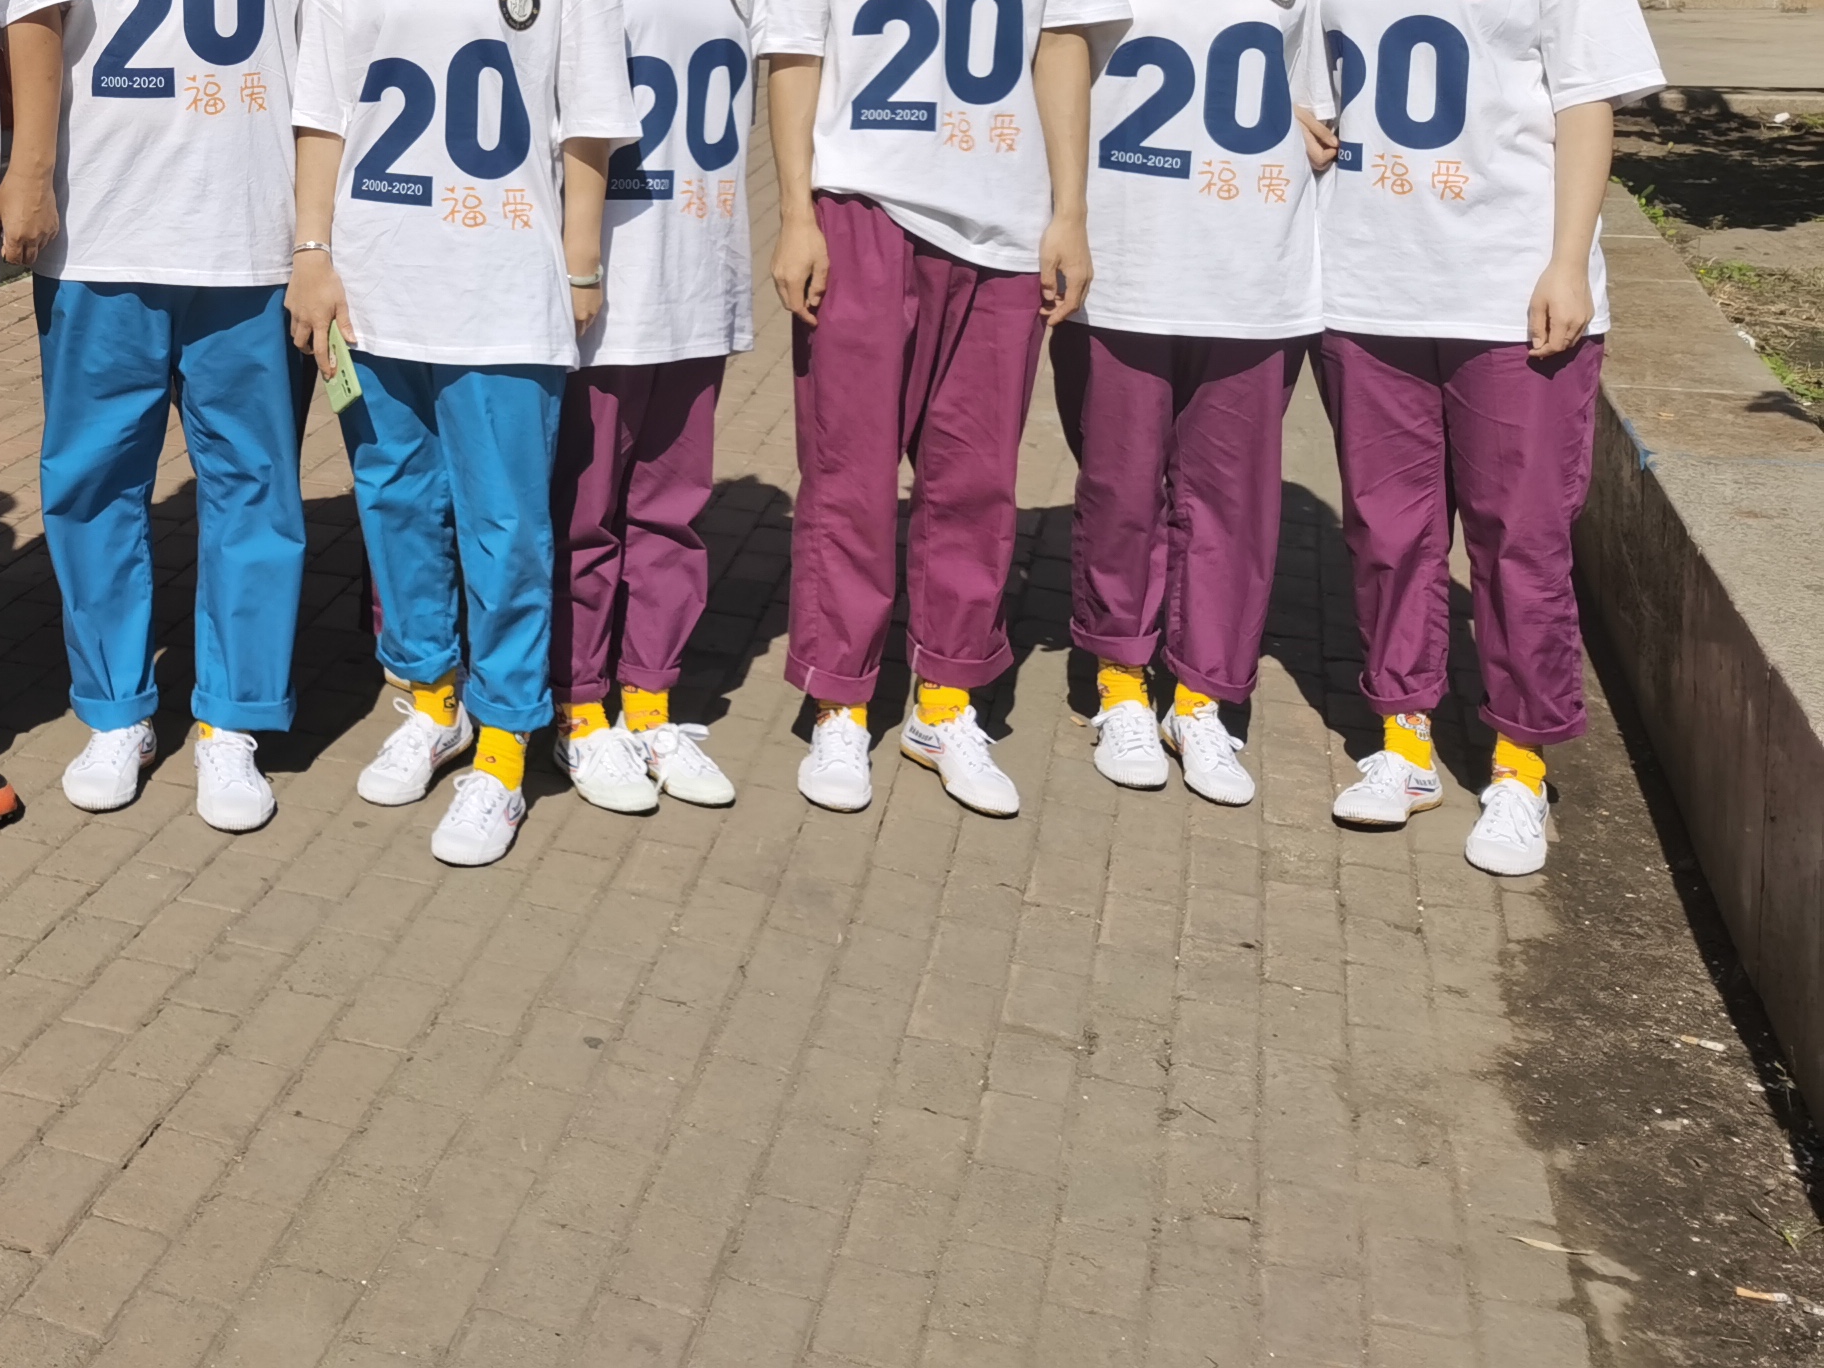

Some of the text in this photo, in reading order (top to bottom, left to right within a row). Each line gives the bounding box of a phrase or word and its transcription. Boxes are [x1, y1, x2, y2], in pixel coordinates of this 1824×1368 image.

[100, 75, 165, 89] 2000-2020
[1098, 21, 1292, 180] 20
[351, 38, 531, 207] 20
[605, 38, 748, 200] 20
[860, 109, 928, 122] 2000-2020
[1110, 150, 1181, 169] 2000-2020
[361, 178, 423, 197] 2000-2020
